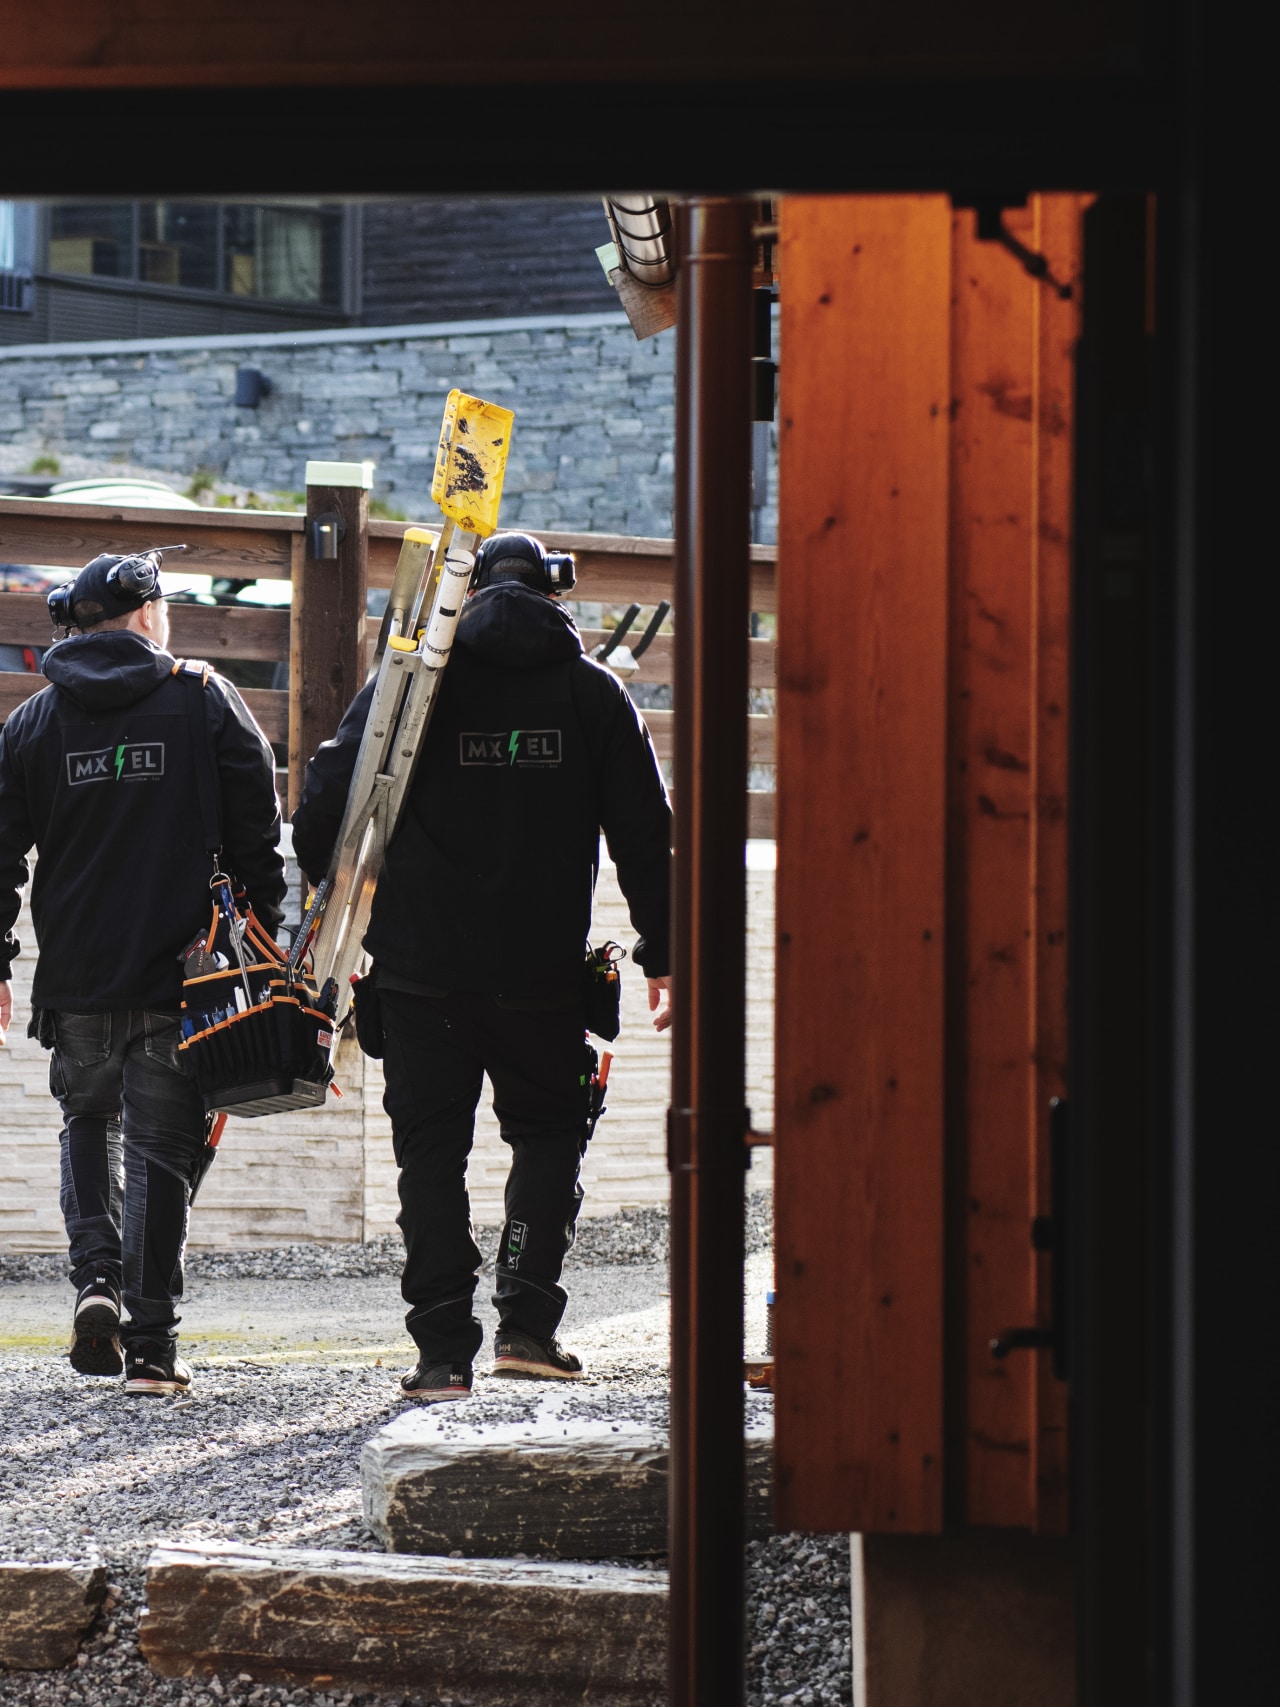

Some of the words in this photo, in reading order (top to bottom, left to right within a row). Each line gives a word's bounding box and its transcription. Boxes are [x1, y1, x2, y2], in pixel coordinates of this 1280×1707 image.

[468, 740, 503, 758] MX
[527, 738, 554, 755] EL
[75, 755, 109, 778] MX
[131, 750, 157, 769] EL
[511, 1226, 522, 1242] EL
[450, 1374, 463, 1382] HH
